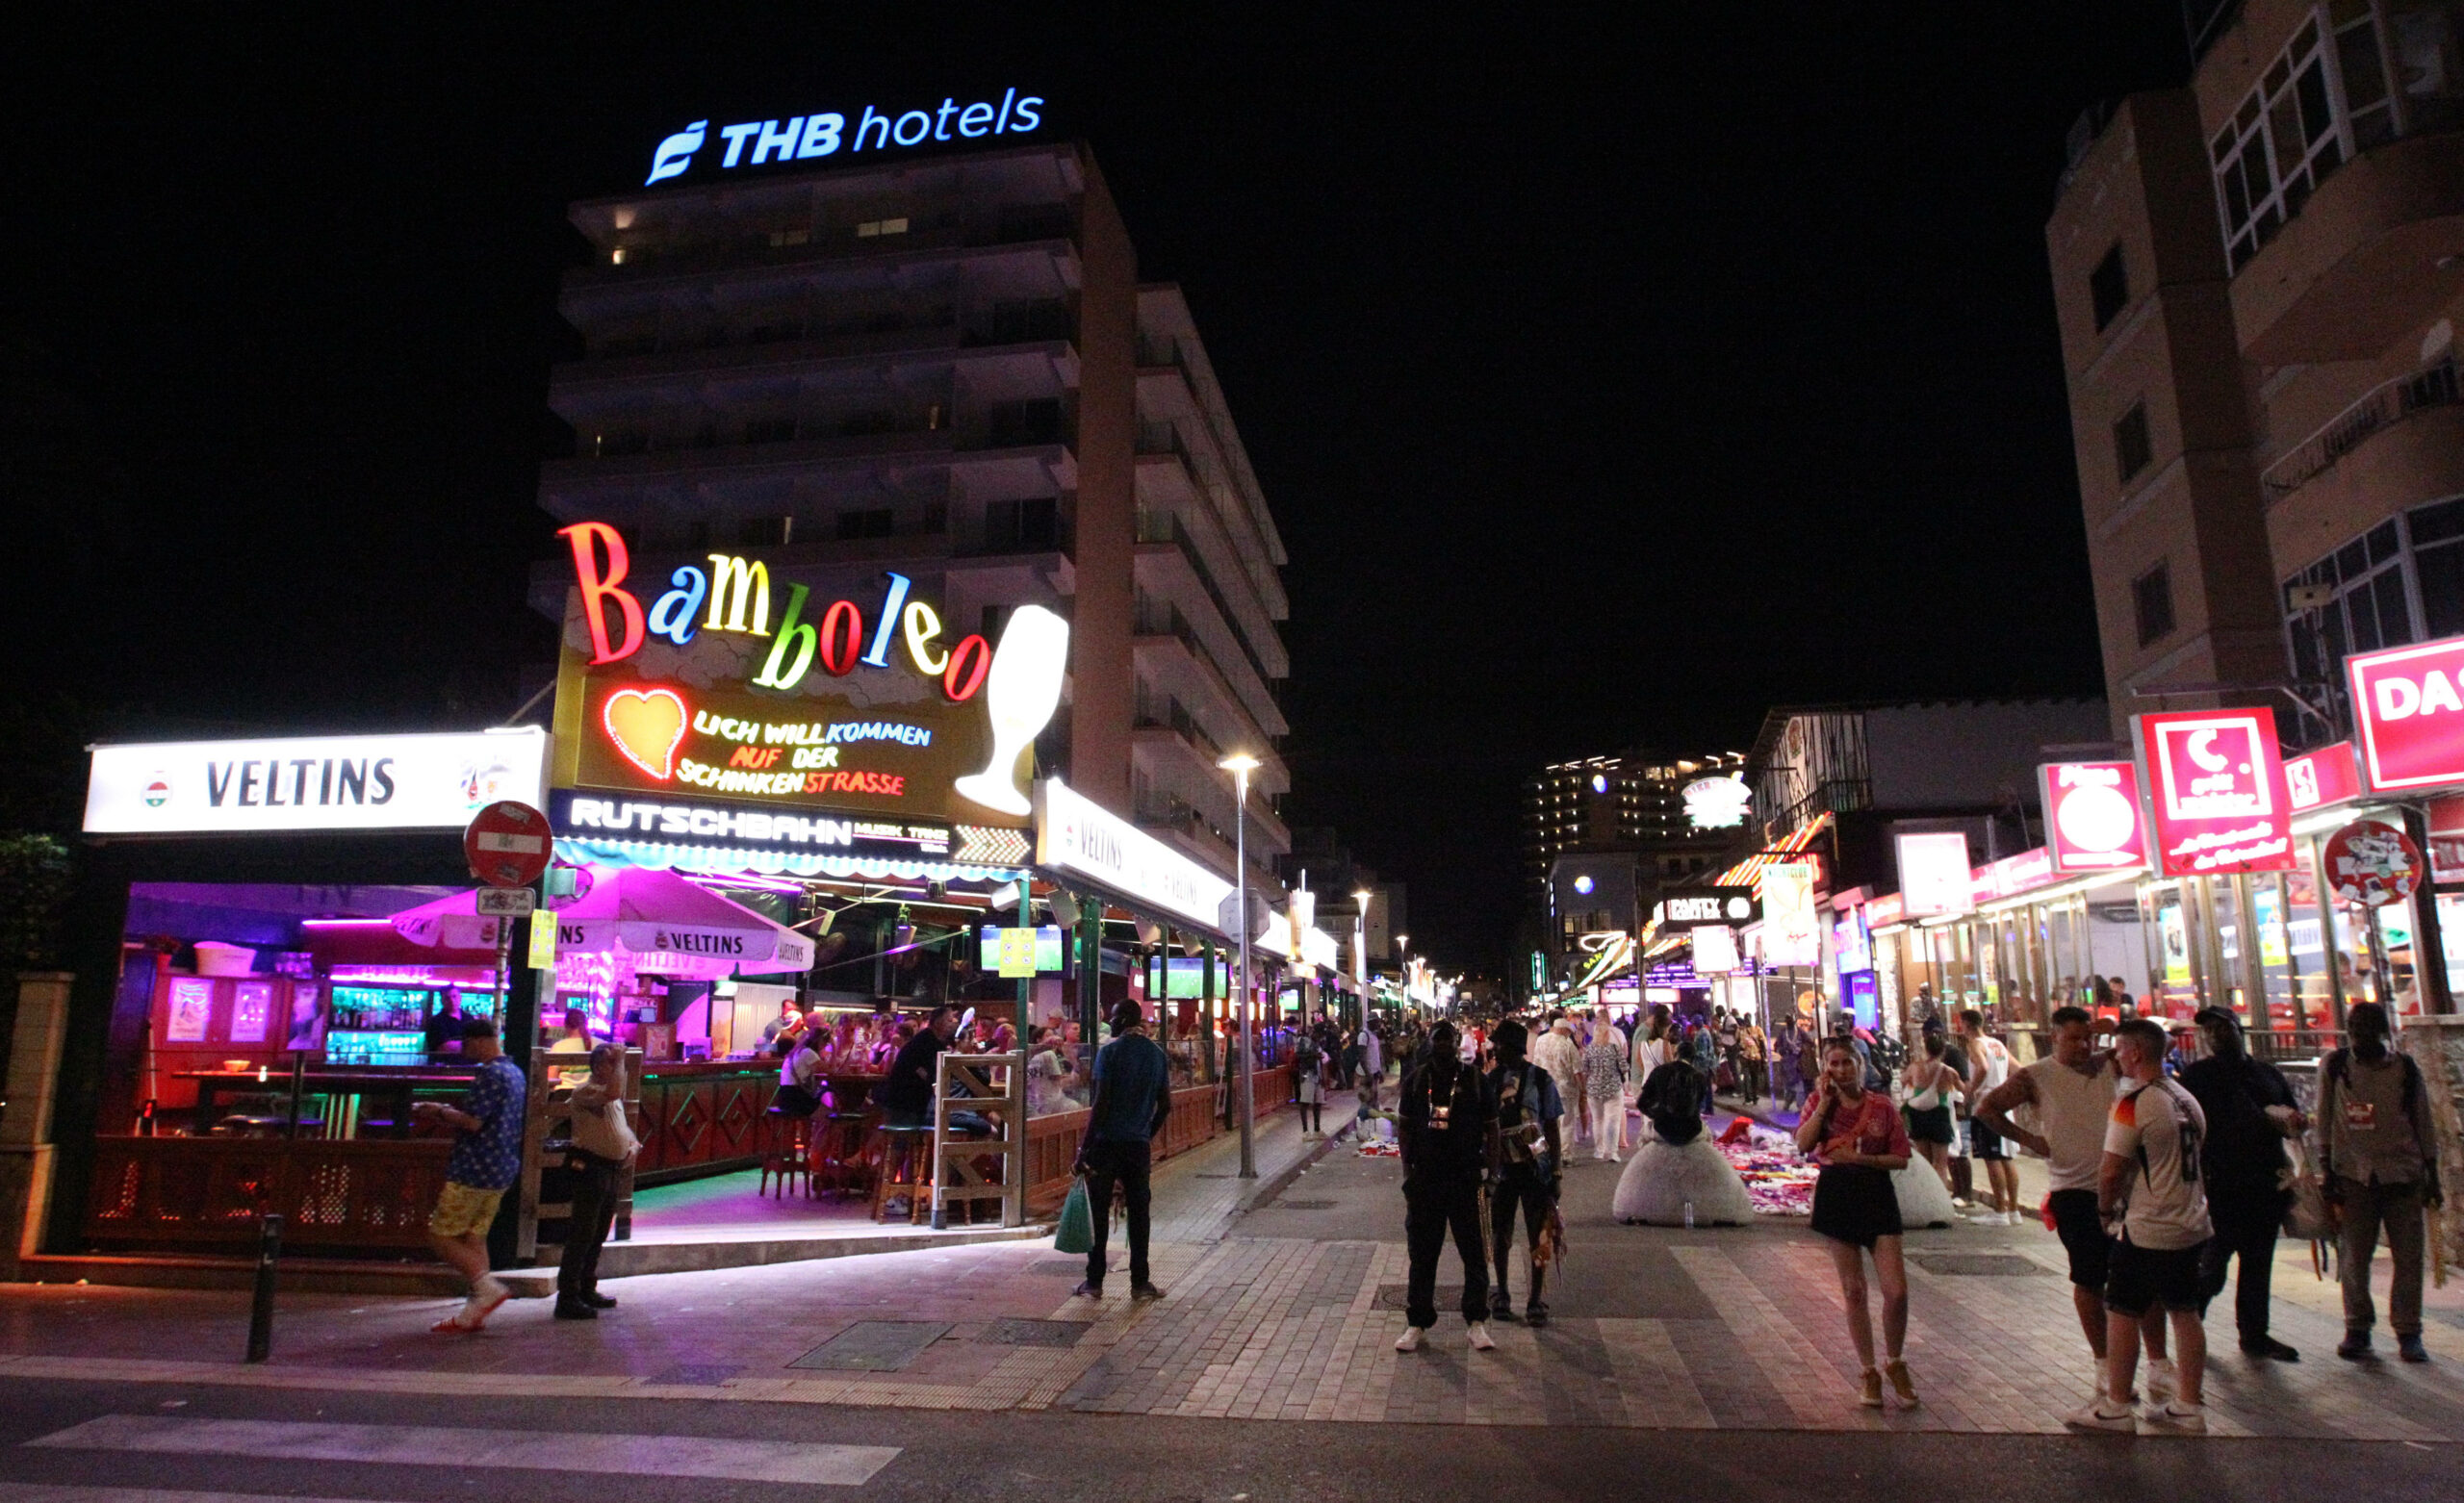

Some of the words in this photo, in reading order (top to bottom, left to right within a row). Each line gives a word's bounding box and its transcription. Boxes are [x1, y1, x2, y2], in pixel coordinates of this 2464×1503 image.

[721, 113, 844, 167] THB
[853, 88, 1044, 151] hotels
[557, 522, 990, 701] Bamboleo
[2374, 670, 2464, 721] DA
[692, 711, 757, 745] LICH
[764, 722, 931, 747] WILLKOMMEN
[207, 757, 395, 807] VELTINS
[676, 759, 905, 796] SCHINKENSTRASSE
[730, 747, 782, 769] AUF
[792, 747, 838, 769] DER
[571, 799, 854, 848] RUTSCHBAHN
[1081, 816, 1122, 871] VELTINS
[1171, 870, 1197, 905] VELTINS
[671, 933, 743, 954] VELTINS
